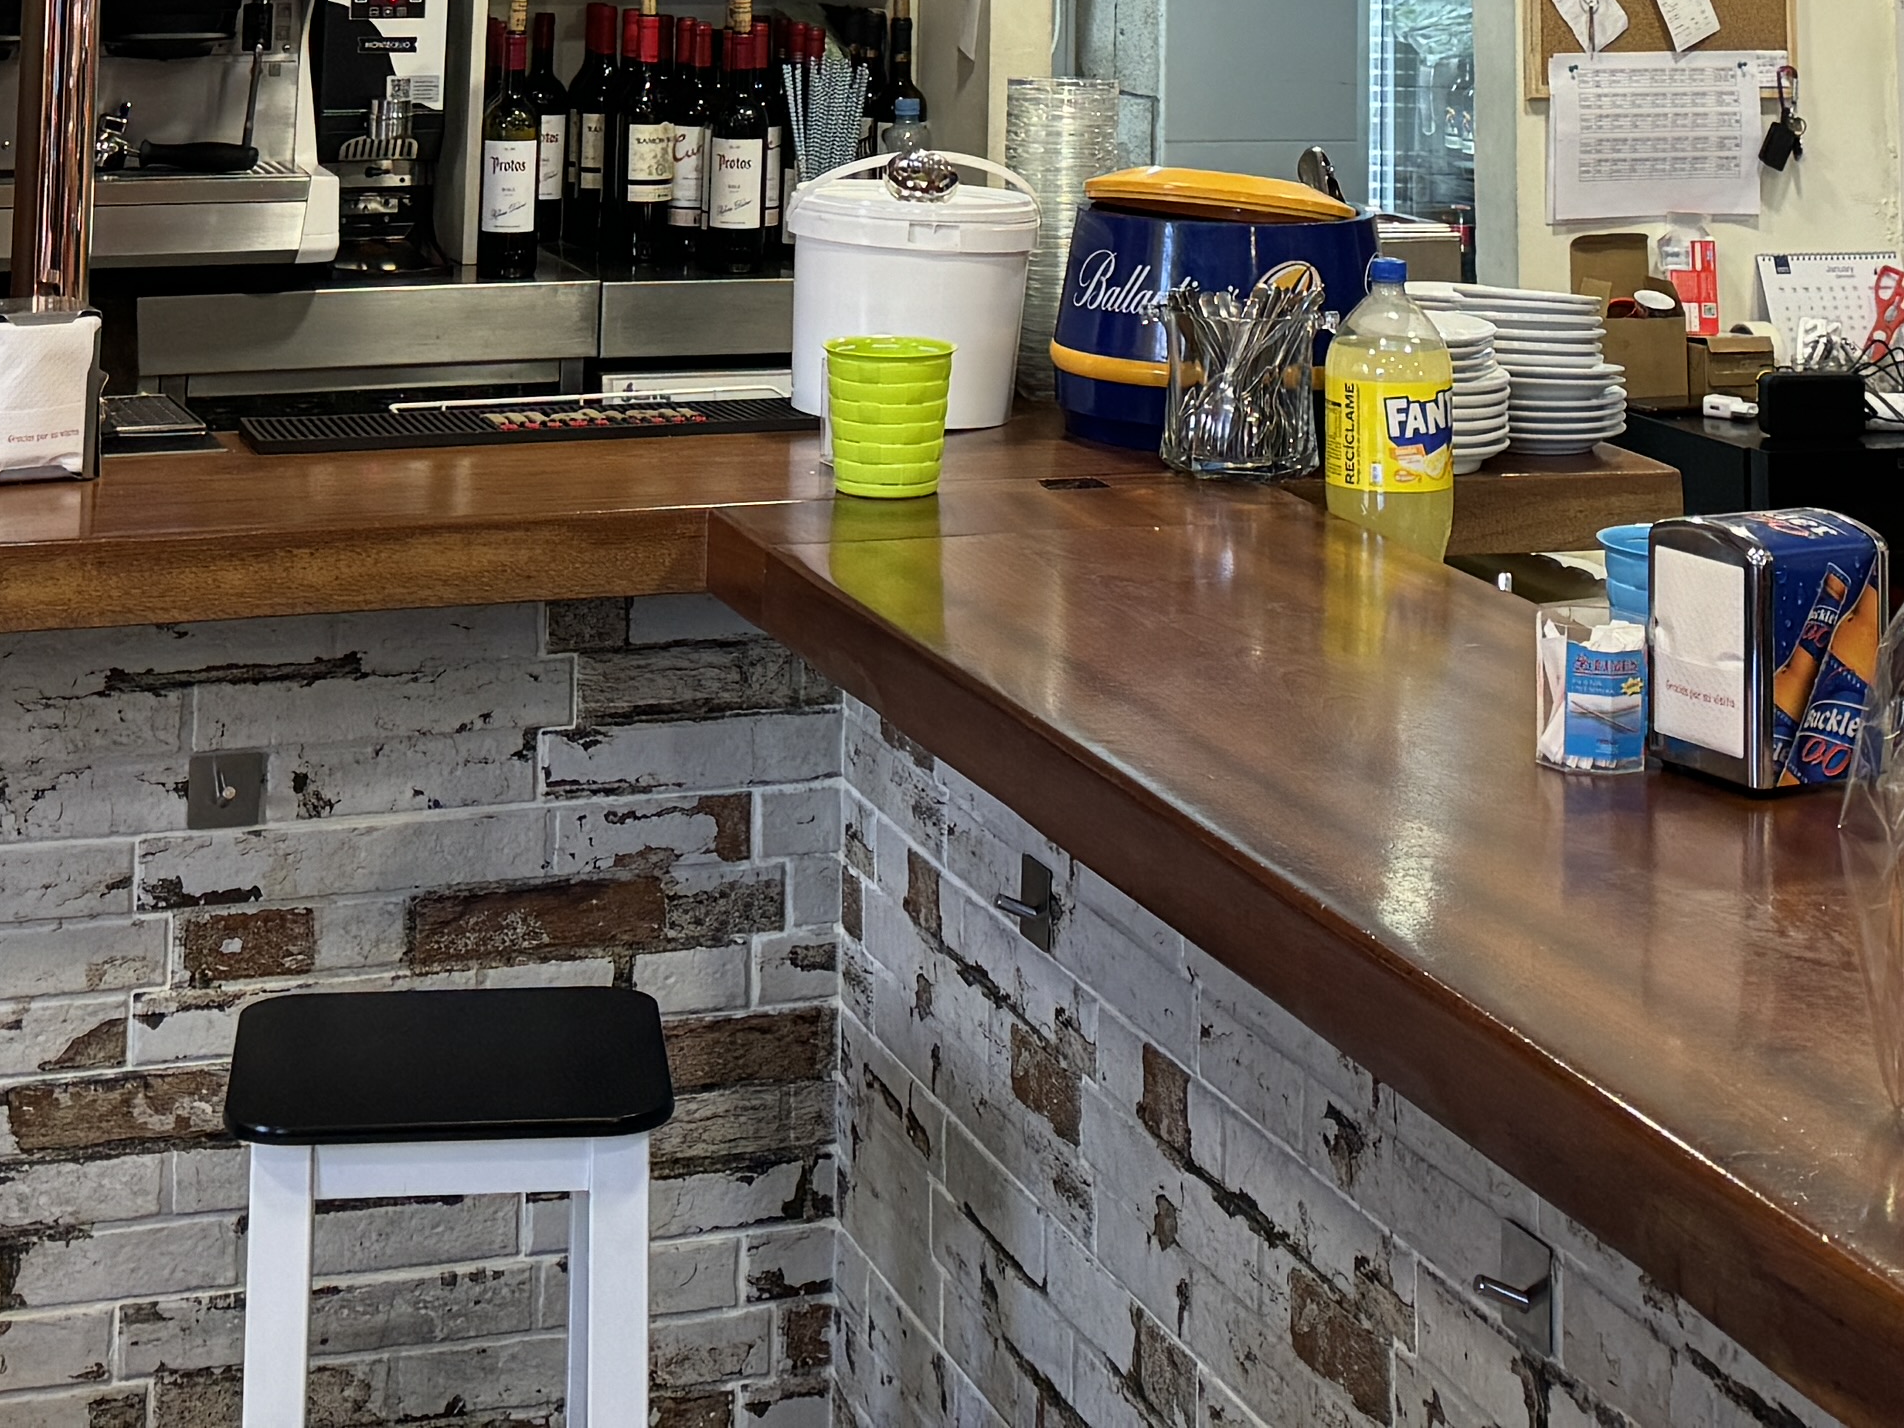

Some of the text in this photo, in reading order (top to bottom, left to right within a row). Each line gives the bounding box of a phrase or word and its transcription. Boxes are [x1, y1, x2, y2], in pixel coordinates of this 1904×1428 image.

[490, 155, 527, 175] Protos
[716, 154, 752, 172] Protos
[7, 434, 35, 443] Gracias
[36, 433, 49, 443] por
[1342, 382, 1357, 487] RECÍCLAME
[1665, 679, 1689, 698] Gracias
[1689, 688, 1702, 704] por
